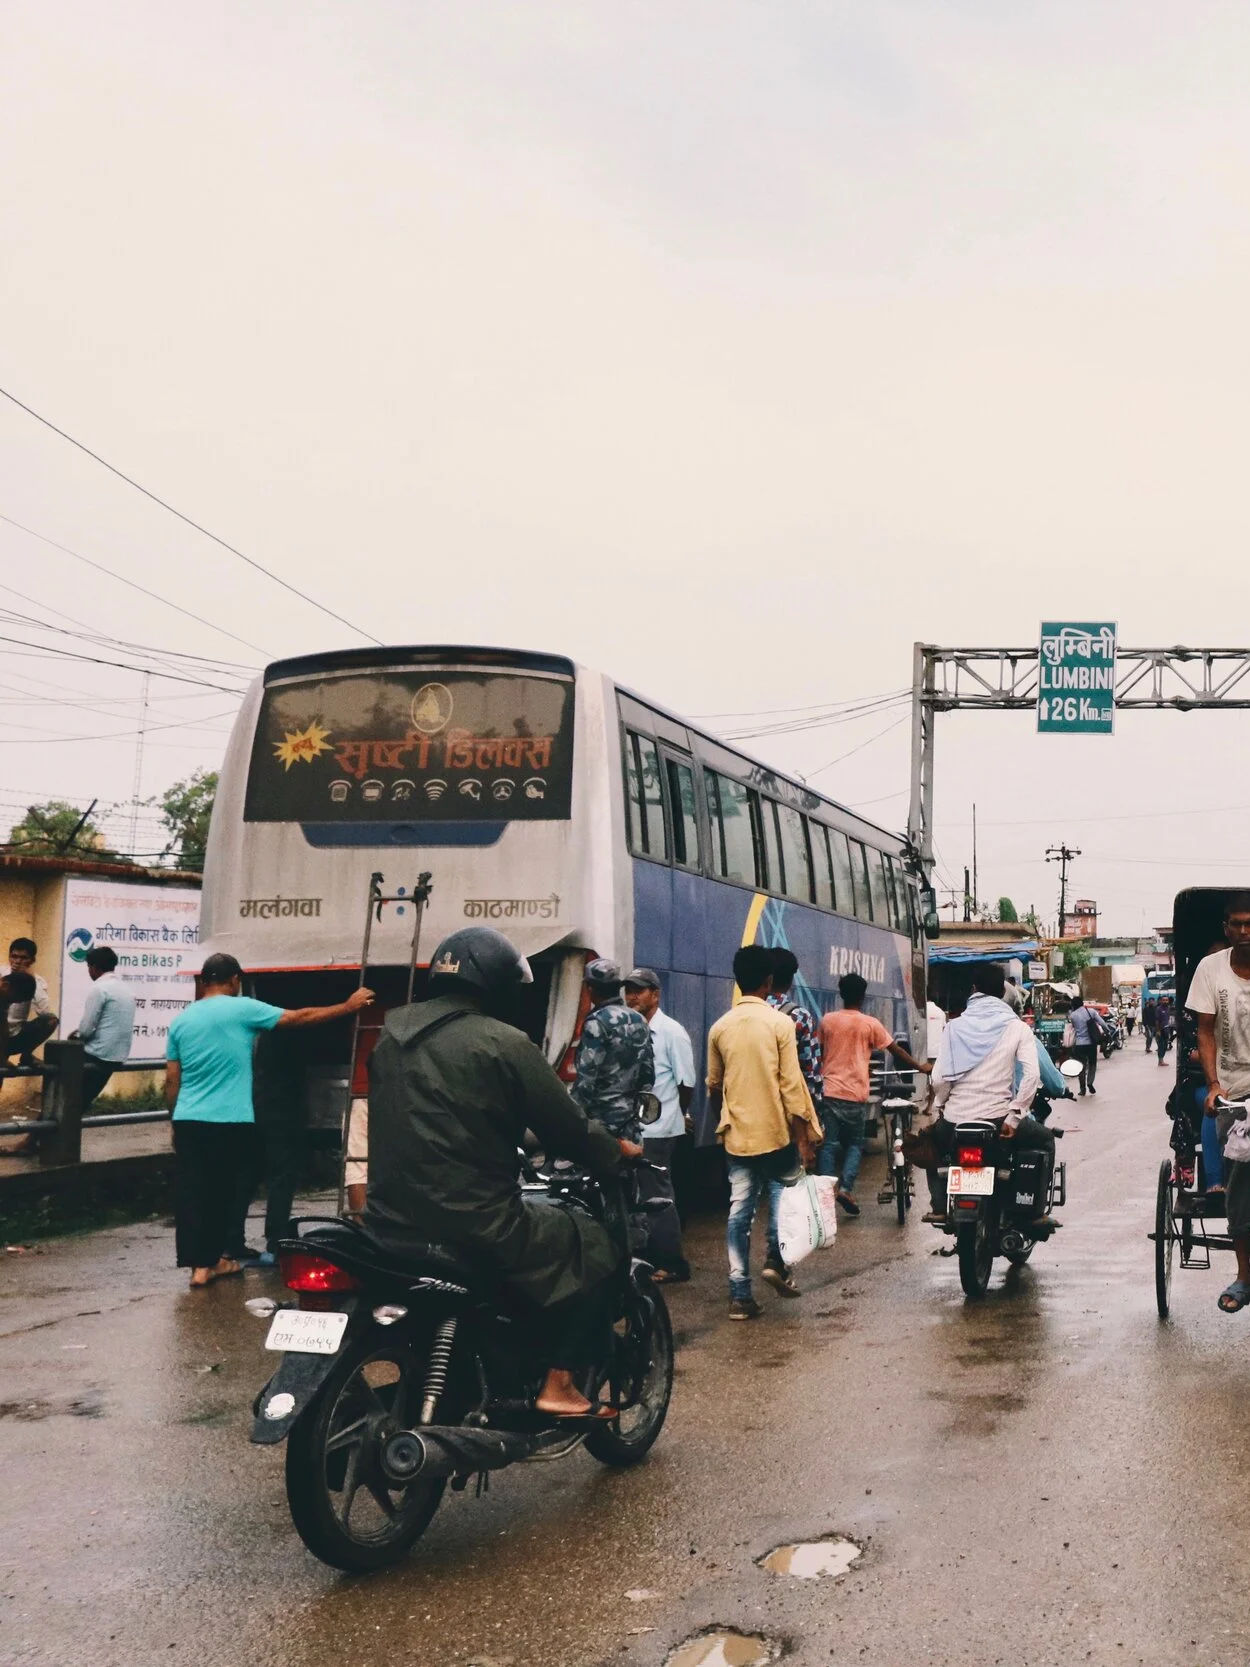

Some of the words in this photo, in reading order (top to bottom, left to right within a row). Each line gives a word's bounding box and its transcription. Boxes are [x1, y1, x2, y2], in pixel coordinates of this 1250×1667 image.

[1042, 627, 1115, 665] लुम्बिनी
[1040, 666, 1113, 690] LUMBINI
[1051, 697, 1077, 721] 26
[444, 728, 553, 770] डिलक्स
[239, 895, 322, 918] मलंगवा
[96, 922, 127, 941] गरिमा
[129, 924, 160, 942] विकास
[141, 954, 174, 968] Bikas
[830, 945, 885, 983] KRISHNA
